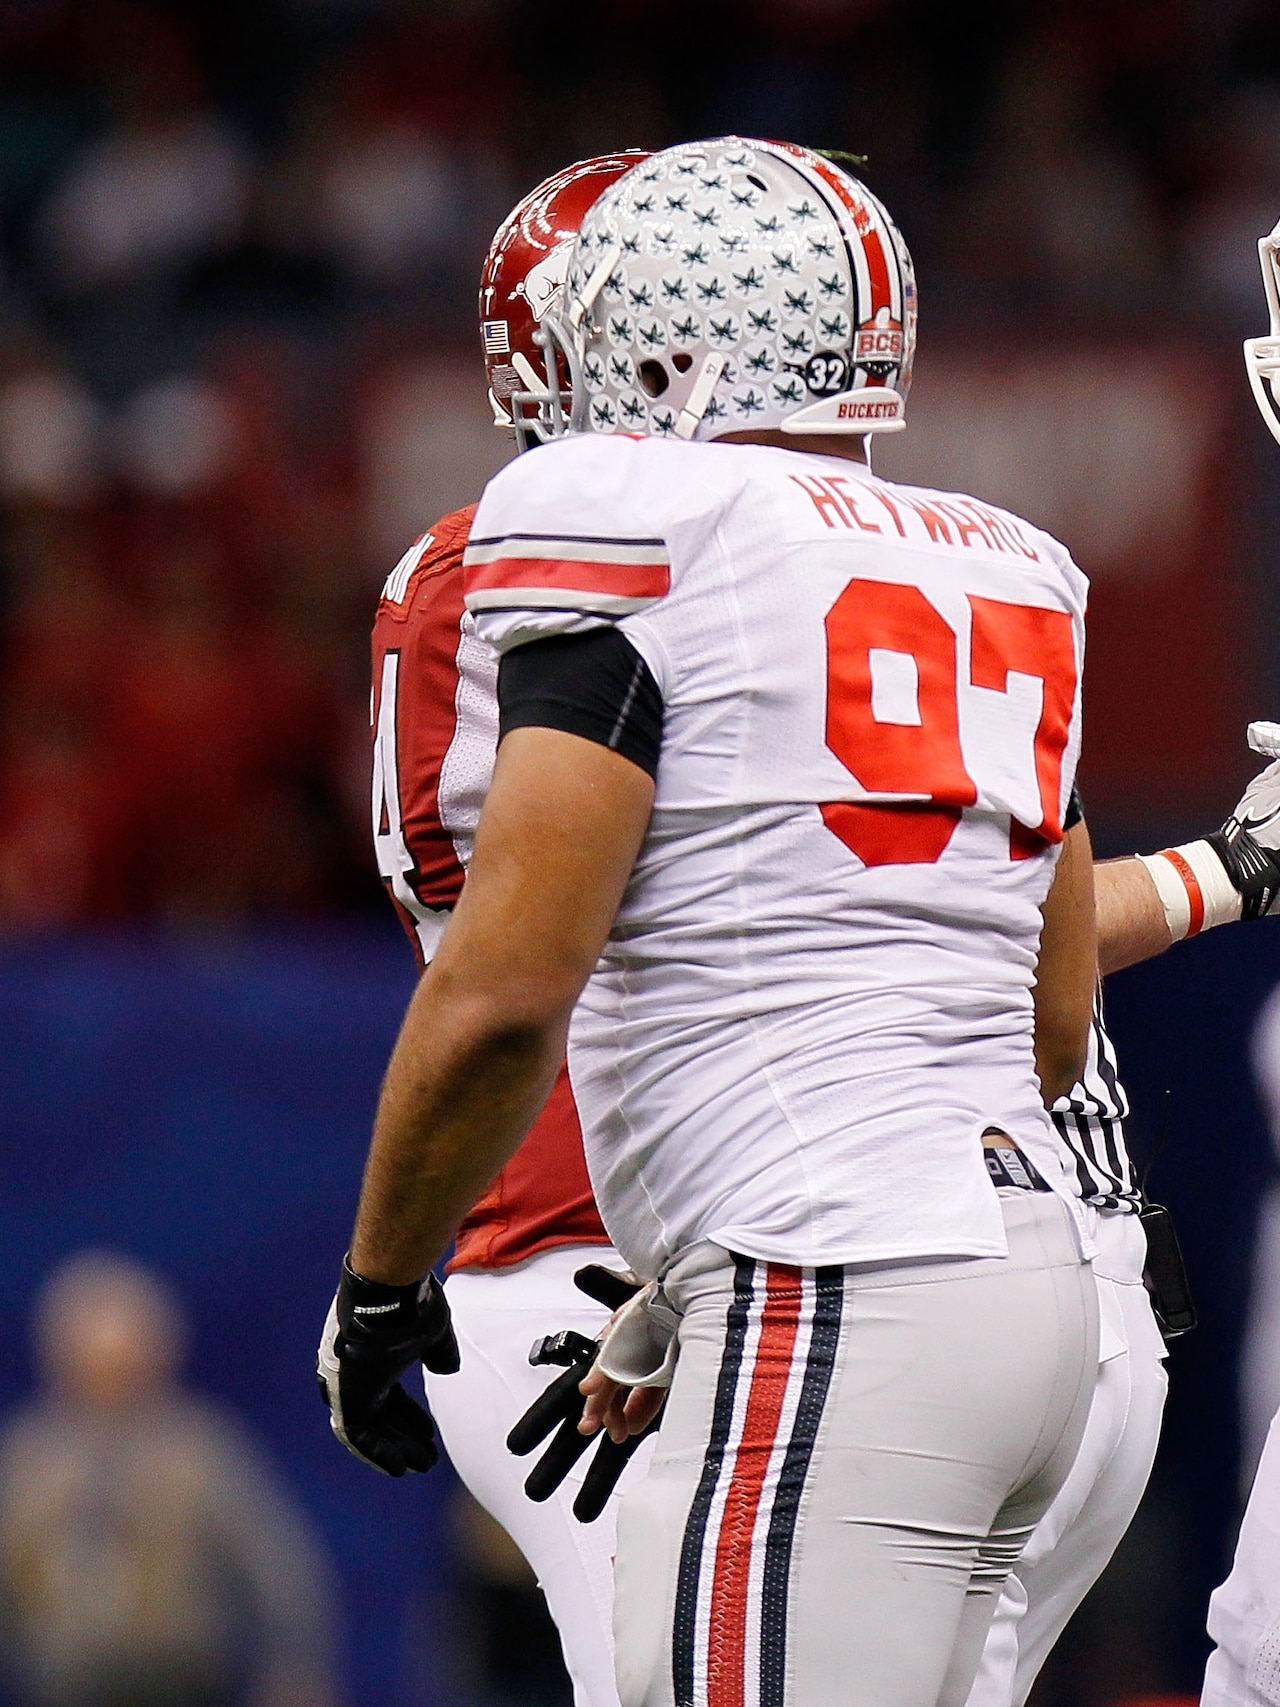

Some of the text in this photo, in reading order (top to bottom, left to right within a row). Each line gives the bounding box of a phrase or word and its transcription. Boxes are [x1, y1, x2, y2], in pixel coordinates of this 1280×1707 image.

[808, 358, 844, 390] 32
[860, 334, 900, 352] BCS
[788, 474, 1040, 563] HEYWARD
[817, 577, 1077, 868] 97
[370, 652, 450, 966] 4
